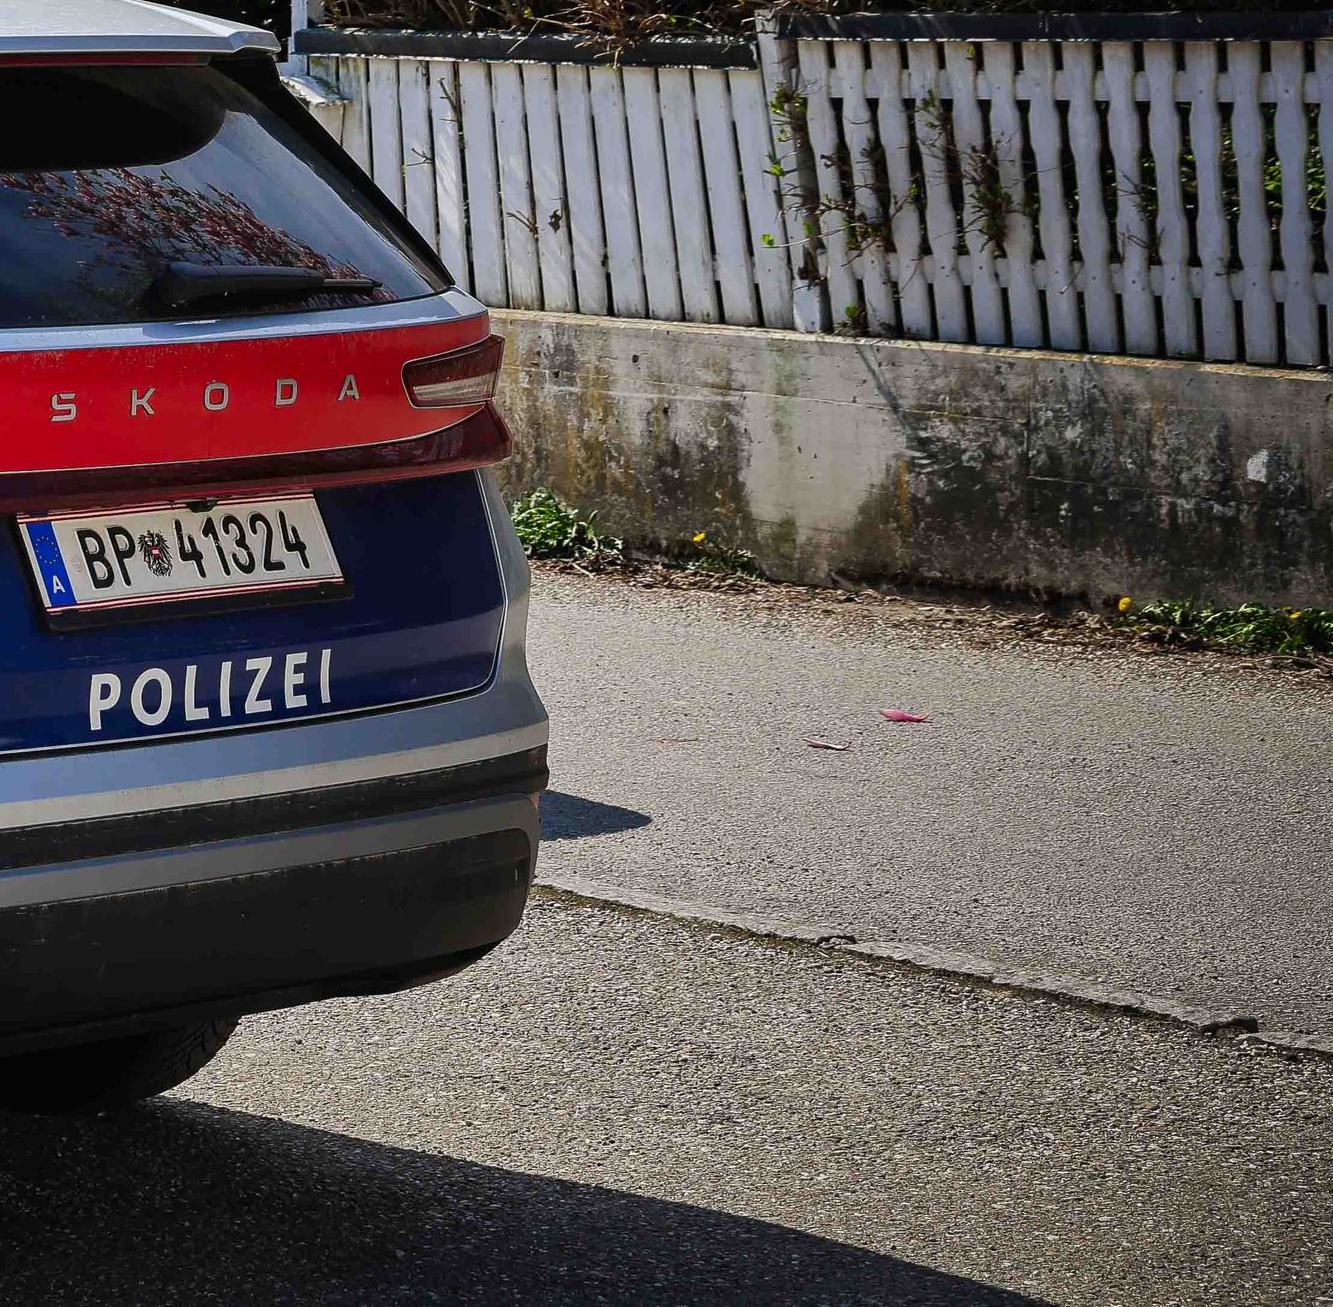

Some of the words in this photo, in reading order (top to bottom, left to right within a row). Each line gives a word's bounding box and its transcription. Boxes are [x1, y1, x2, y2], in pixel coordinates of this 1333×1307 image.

[53, 575, 65, 595] A
[75, 526, 136, 590] BP
[173, 511, 311, 579] 41324
[89, 648, 332, 731] POLIZEI
